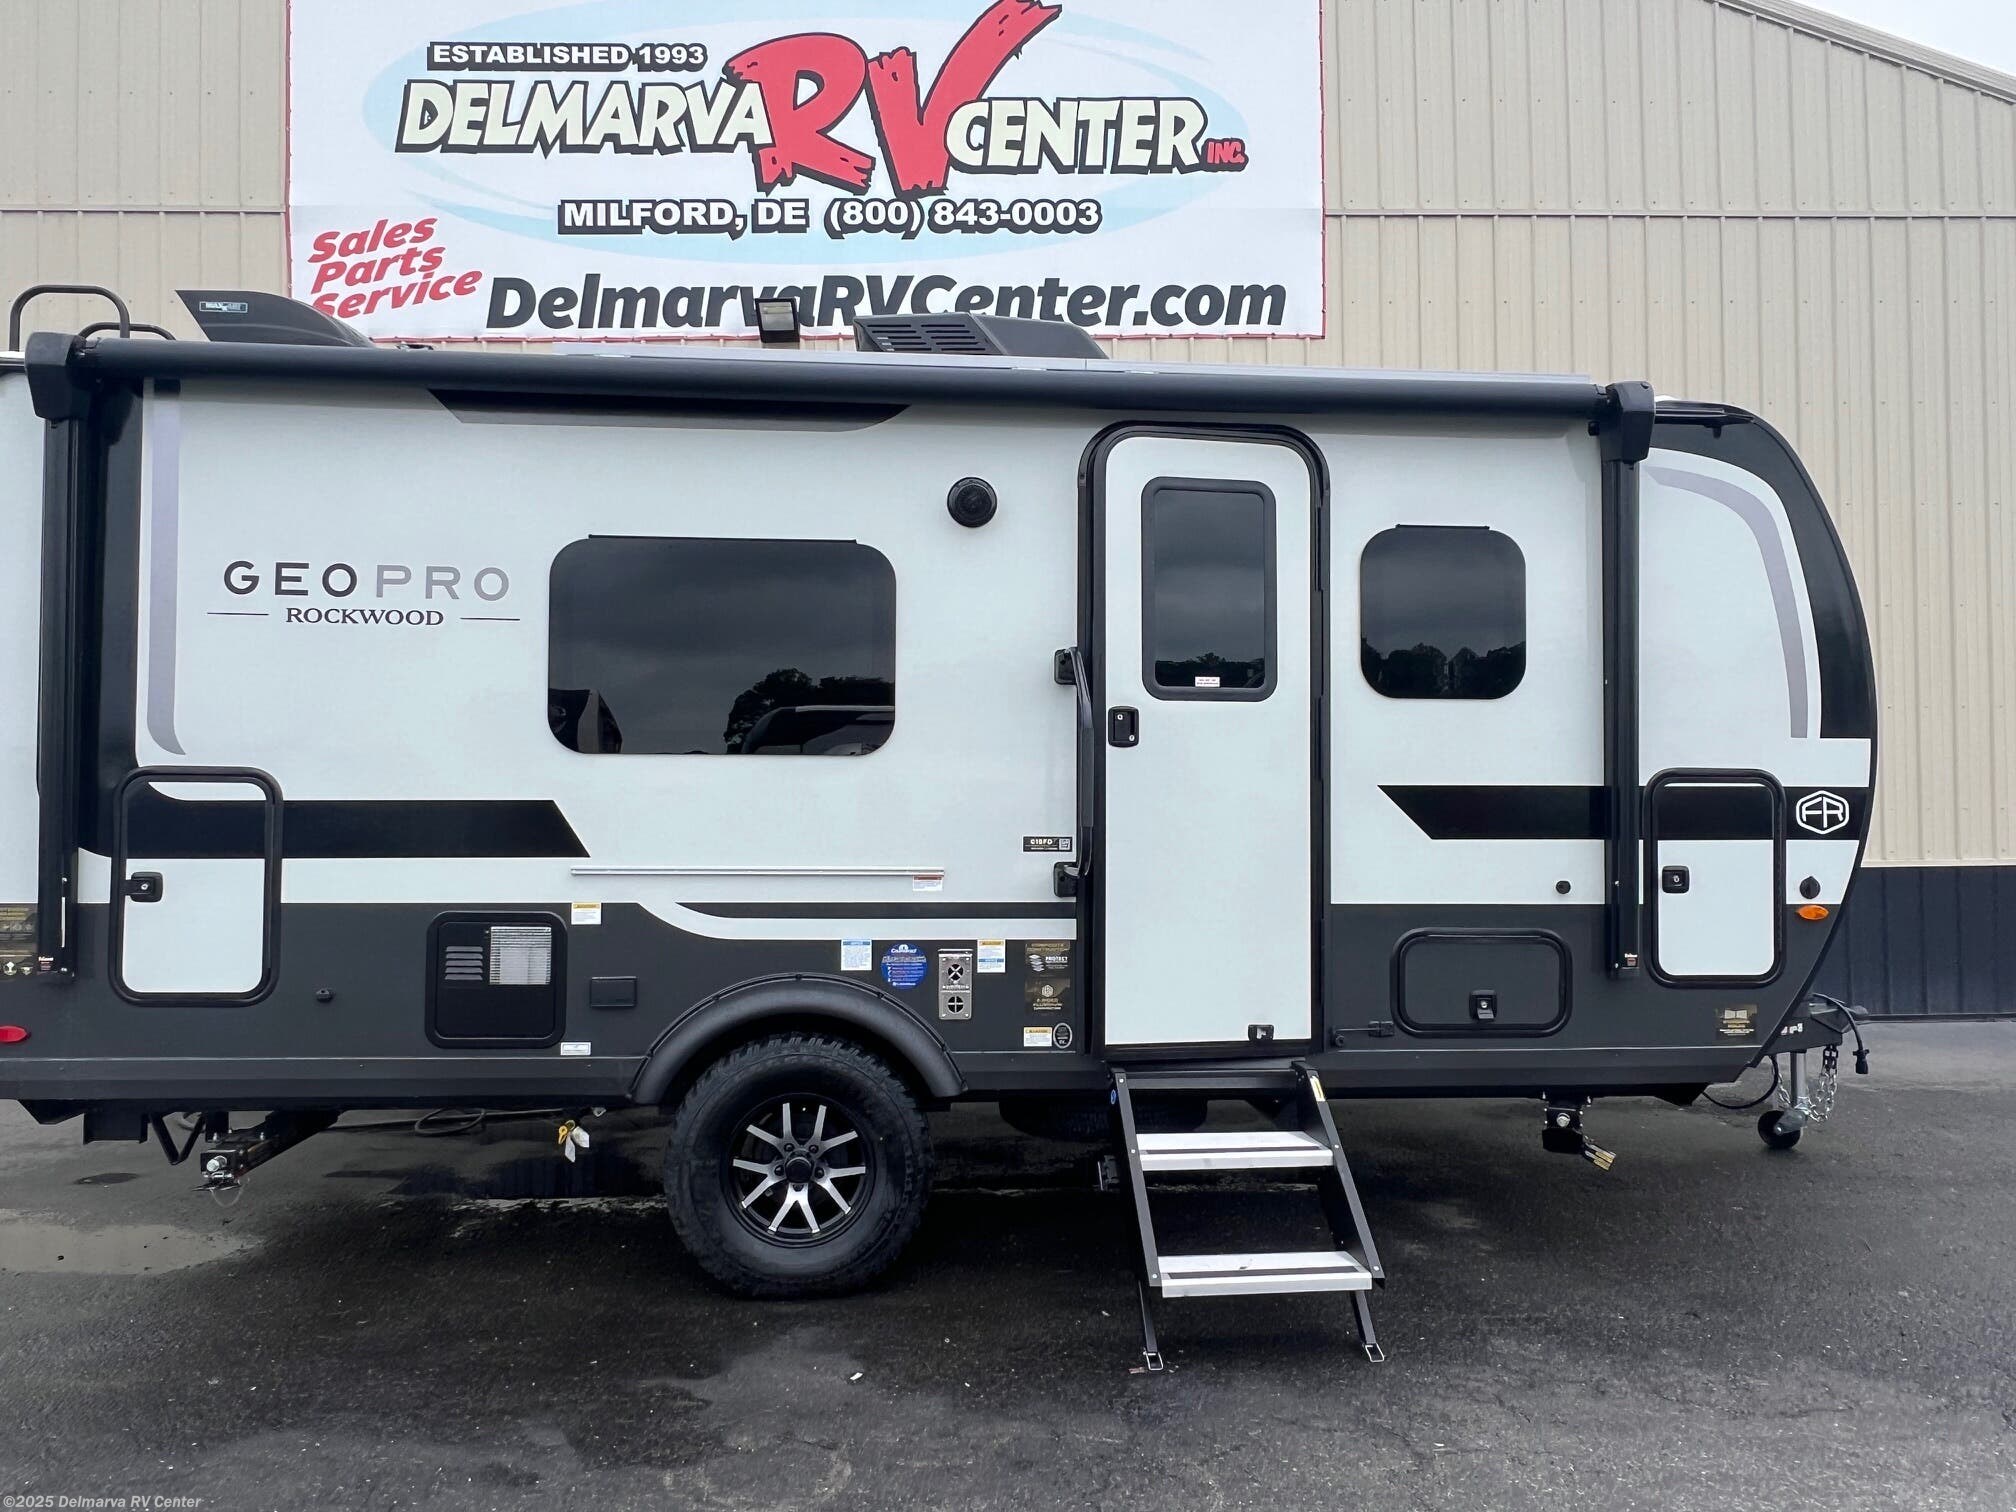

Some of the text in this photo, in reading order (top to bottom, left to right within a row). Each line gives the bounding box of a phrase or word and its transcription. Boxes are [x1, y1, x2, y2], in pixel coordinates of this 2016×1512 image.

[430, 42, 707, 70] ESTABLISHED 1993
[395, 0, 1248, 197] DELMARVA RV CENTER INC.
[308, 217, 438, 263] Sales
[560, 199, 1101, 237] MILFORD, DE (800) 843-0003
[311, 247, 446, 294] Parts
[311, 271, 483, 318] Service
[286, 607, 444, 626] ROCKWOOD
